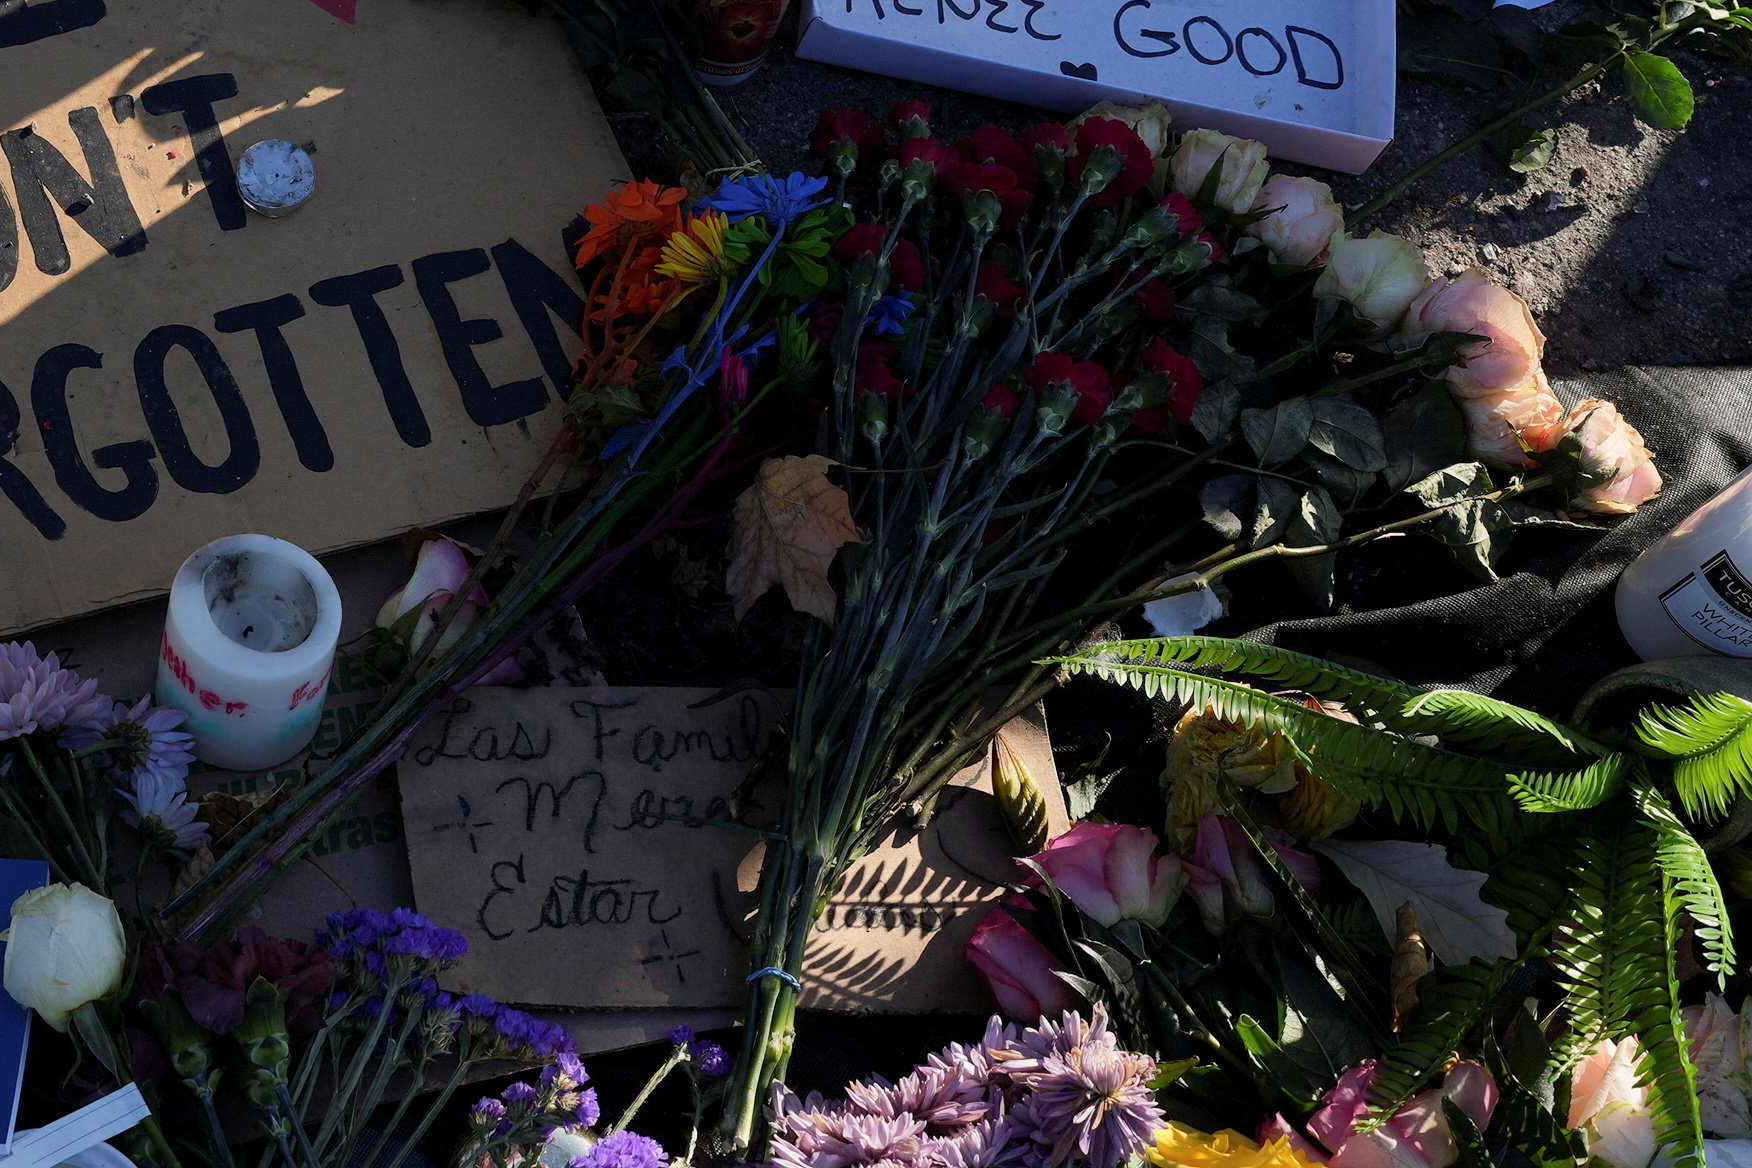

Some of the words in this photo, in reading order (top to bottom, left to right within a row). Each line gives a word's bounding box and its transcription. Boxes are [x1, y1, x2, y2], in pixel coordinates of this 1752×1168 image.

[1113, 0, 1344, 91] GOOD
[1691, 610, 1749, 648] PILLAR
[414, 699, 551, 769] Las
[476, 853, 682, 941] Estar
